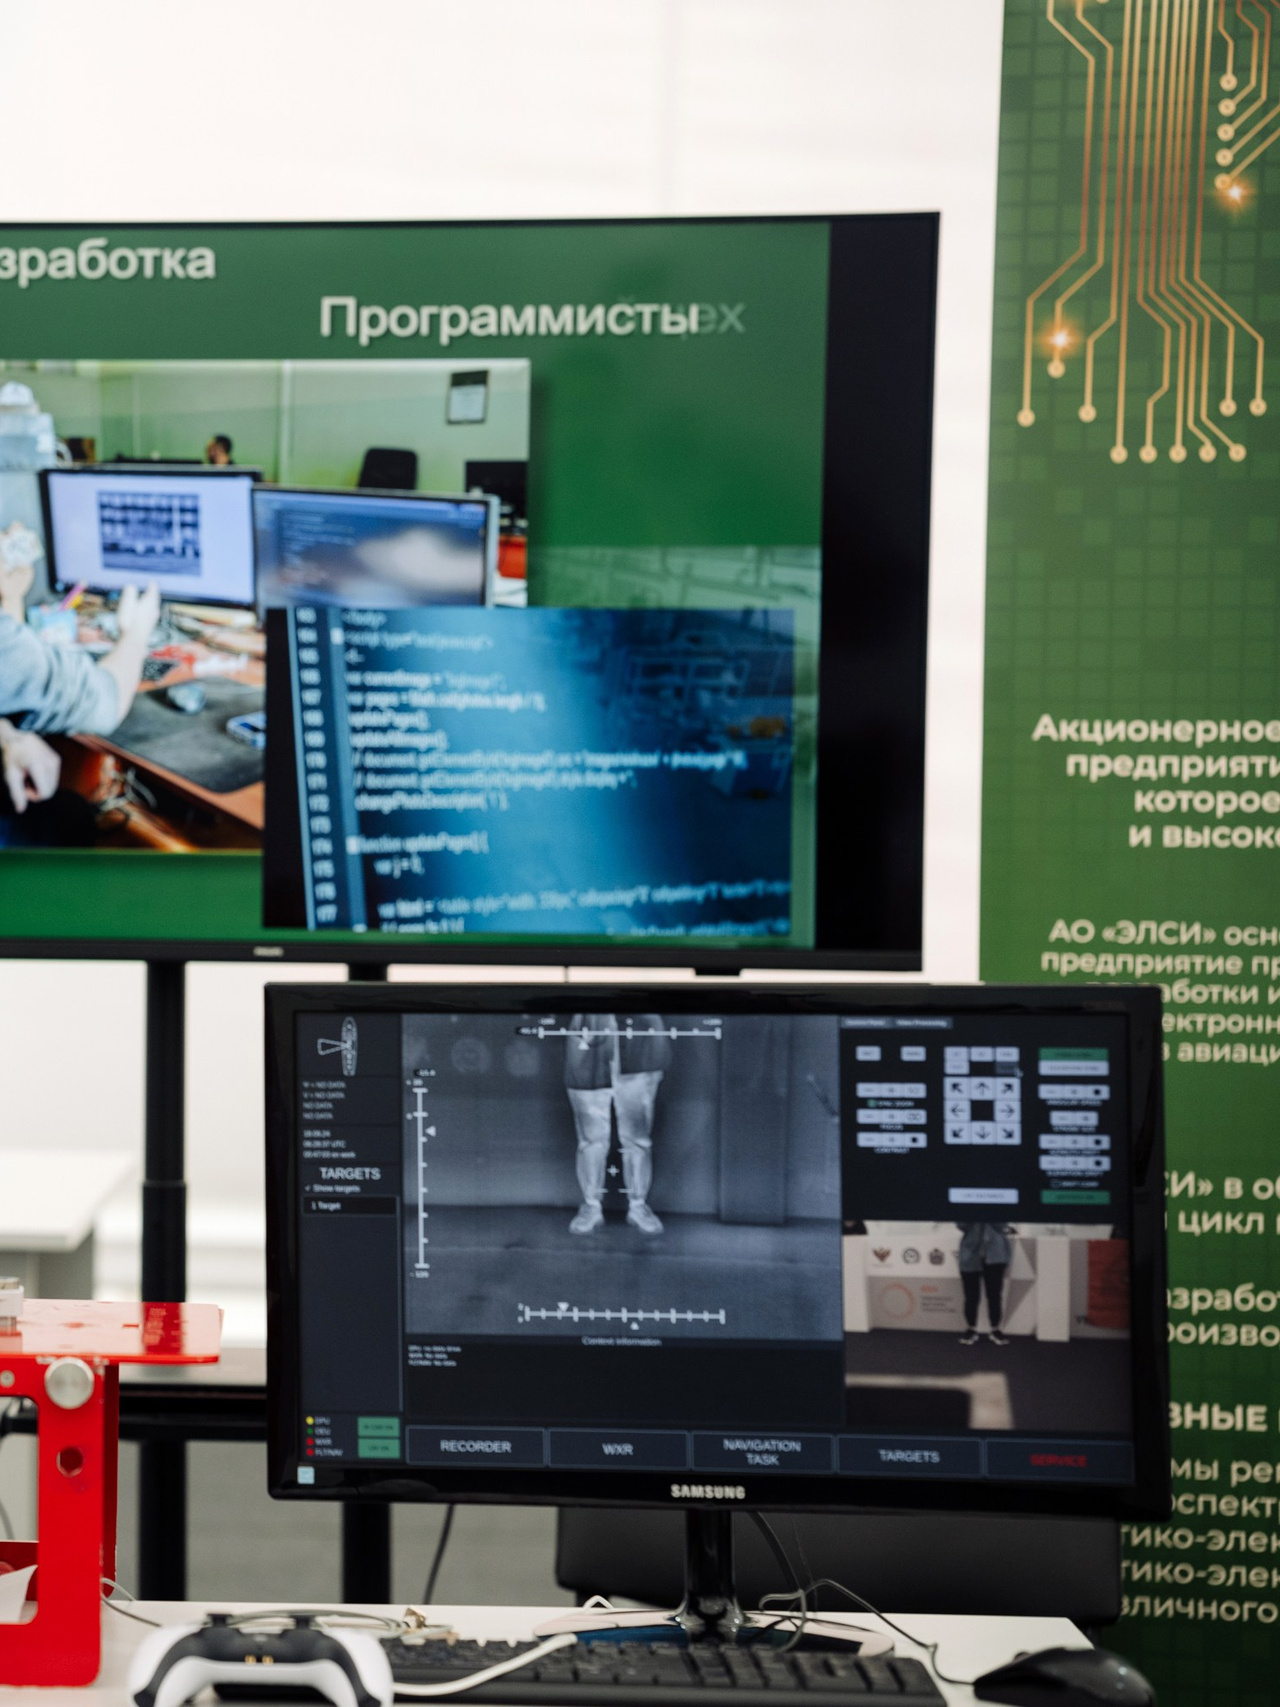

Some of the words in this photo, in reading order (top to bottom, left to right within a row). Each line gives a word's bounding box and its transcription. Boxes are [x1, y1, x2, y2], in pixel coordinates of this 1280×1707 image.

[320, 296, 699, 347] Программисты
[1031, 713, 1280, 748] Акционерное
[1134, 789, 1280, 819] которое
[1129, 825, 1152, 848] и
[1048, 918, 1096, 944] АО
[1101, 919, 1217, 945] «ЭЛСИ»
[1223, 925, 1280, 946] осн
[1041, 951, 1243, 979] предприятие
[319, 1166, 382, 1180] TARGETS
[1178, 1210, 1265, 1236] цикл
[1167, 1282, 1280, 1316] зрабо
[615, 1336, 663, 1347] information
[440, 1439, 512, 1454] RECORDER
[602, 1443, 634, 1456] WXR
[723, 1438, 802, 1453] NAVIGATION
[878, 1449, 940, 1463] TARGETS
[747, 1453, 779, 1466] TASK
[670, 1483, 746, 1499] SAMSUNG
[1171, 1493, 1280, 1525] спект
